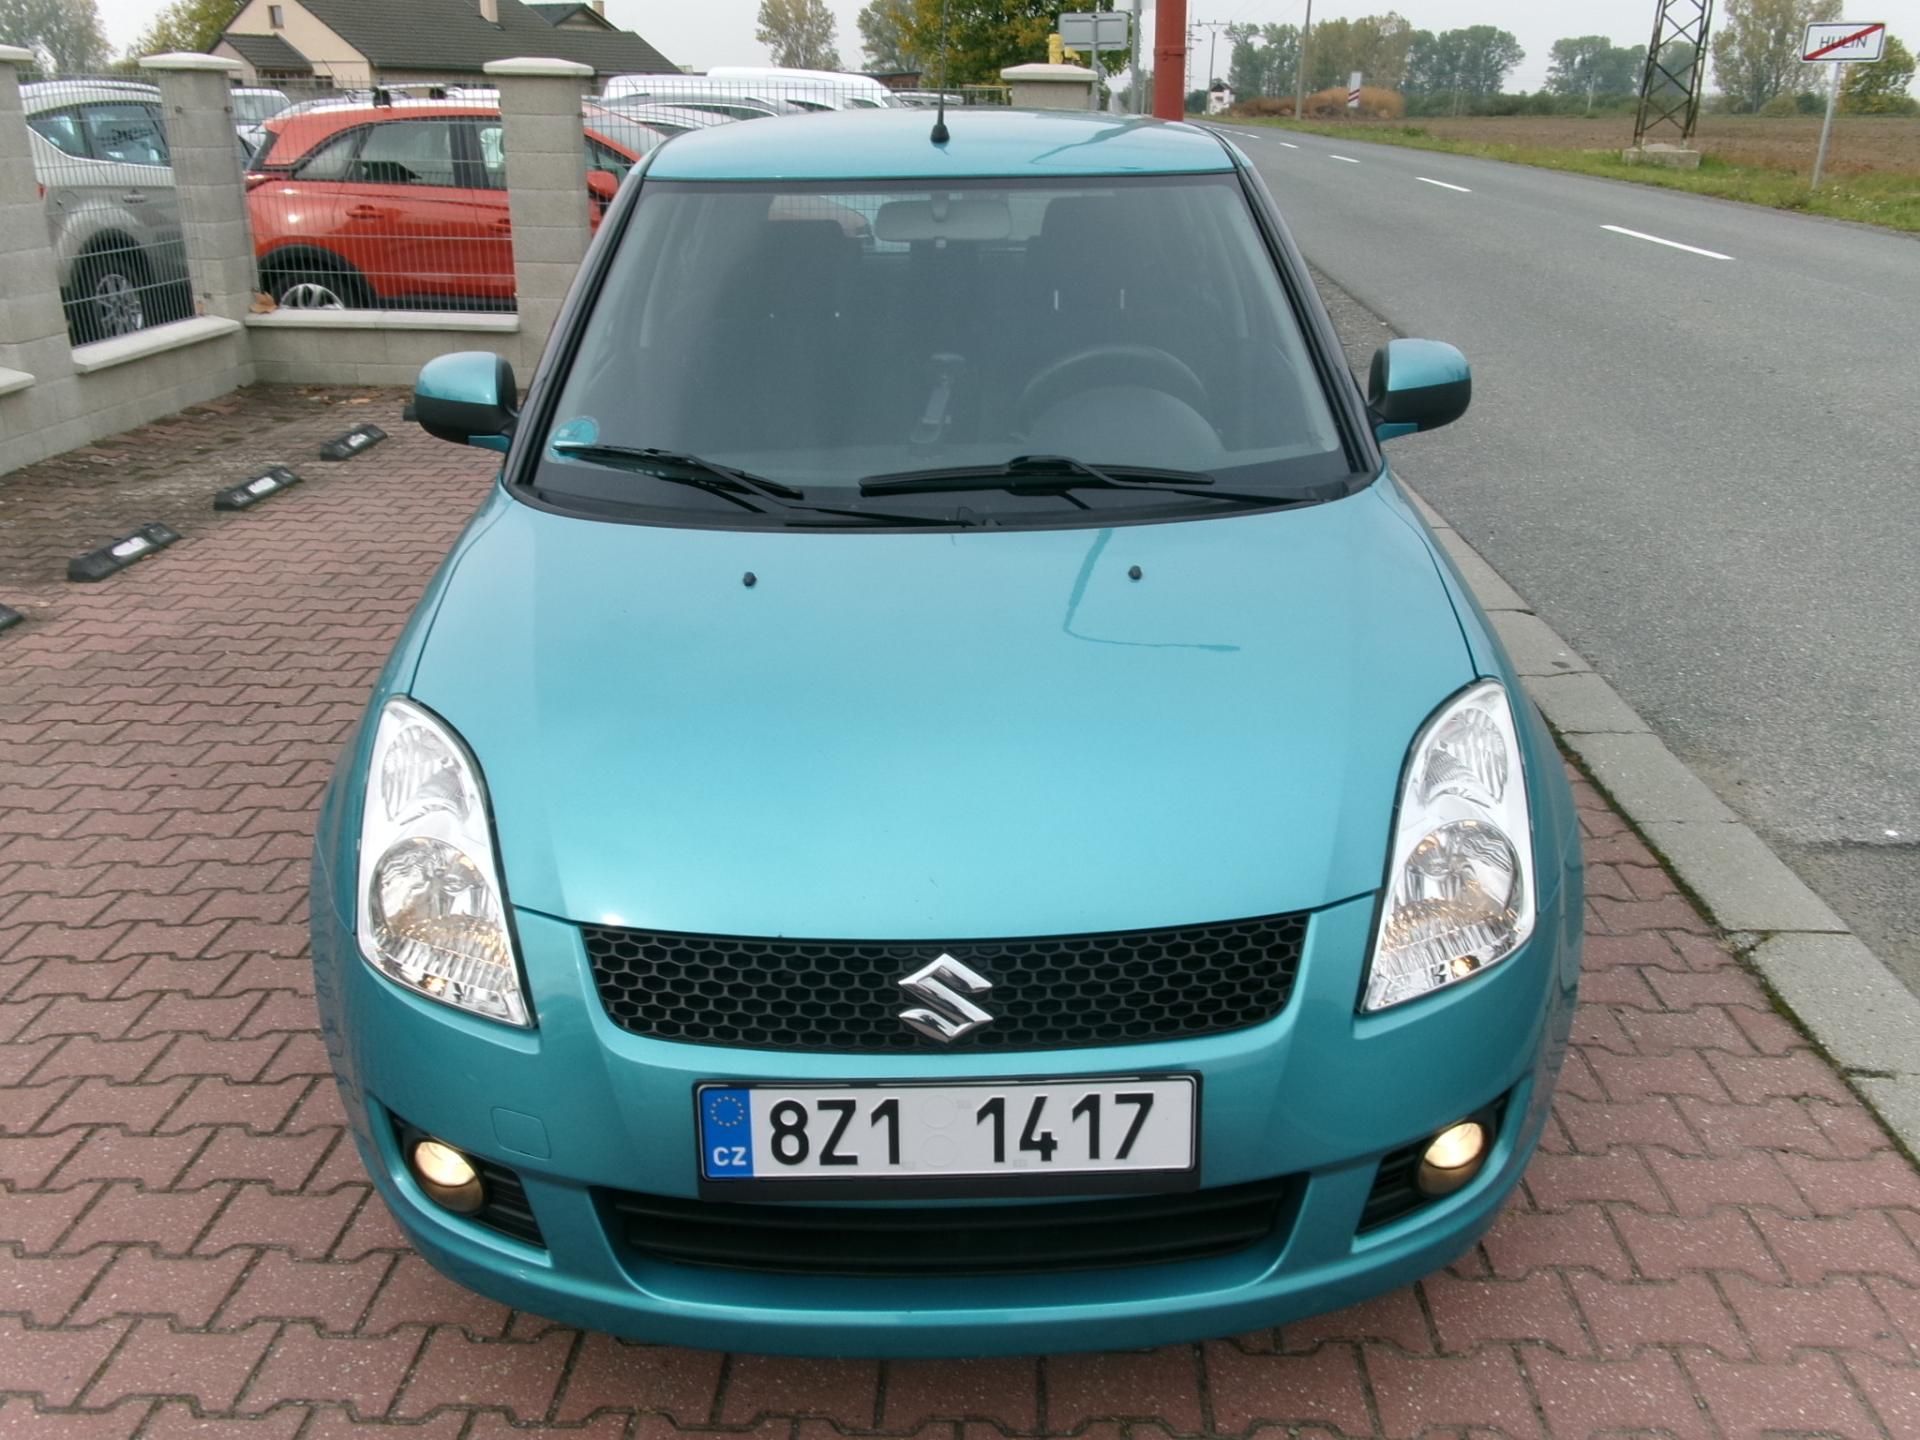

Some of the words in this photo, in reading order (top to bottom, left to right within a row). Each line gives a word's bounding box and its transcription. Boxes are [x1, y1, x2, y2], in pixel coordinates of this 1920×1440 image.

[769, 1099, 901, 1166] 8Z1
[976, 1092, 1155, 1164] 1417
[713, 1147, 747, 1166] CZ
